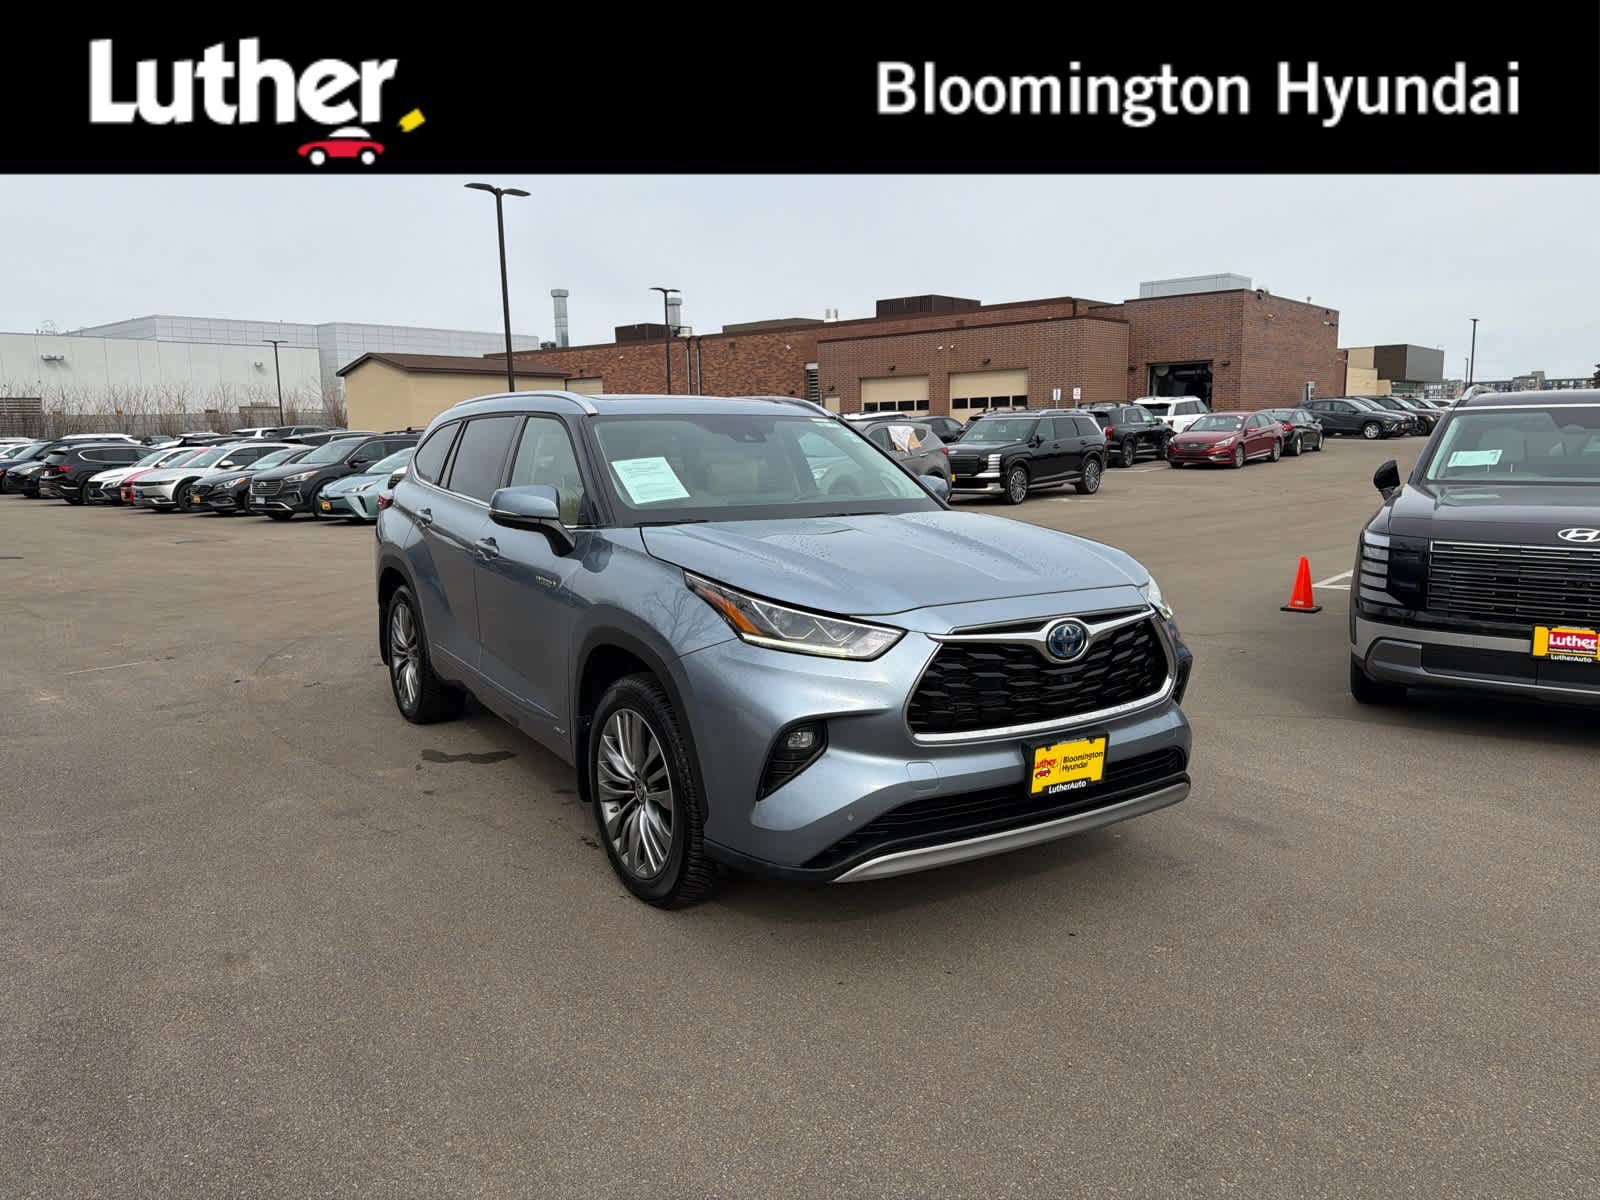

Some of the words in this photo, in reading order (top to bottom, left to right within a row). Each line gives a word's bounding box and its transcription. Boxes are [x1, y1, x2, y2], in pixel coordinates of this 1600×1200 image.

[1549, 634, 1597, 648] Luther
[1063, 752, 1103, 763] Bloomington
[1062, 761, 1088, 772] Hyundai
[1048, 780, 1086, 793] LutherAuto
